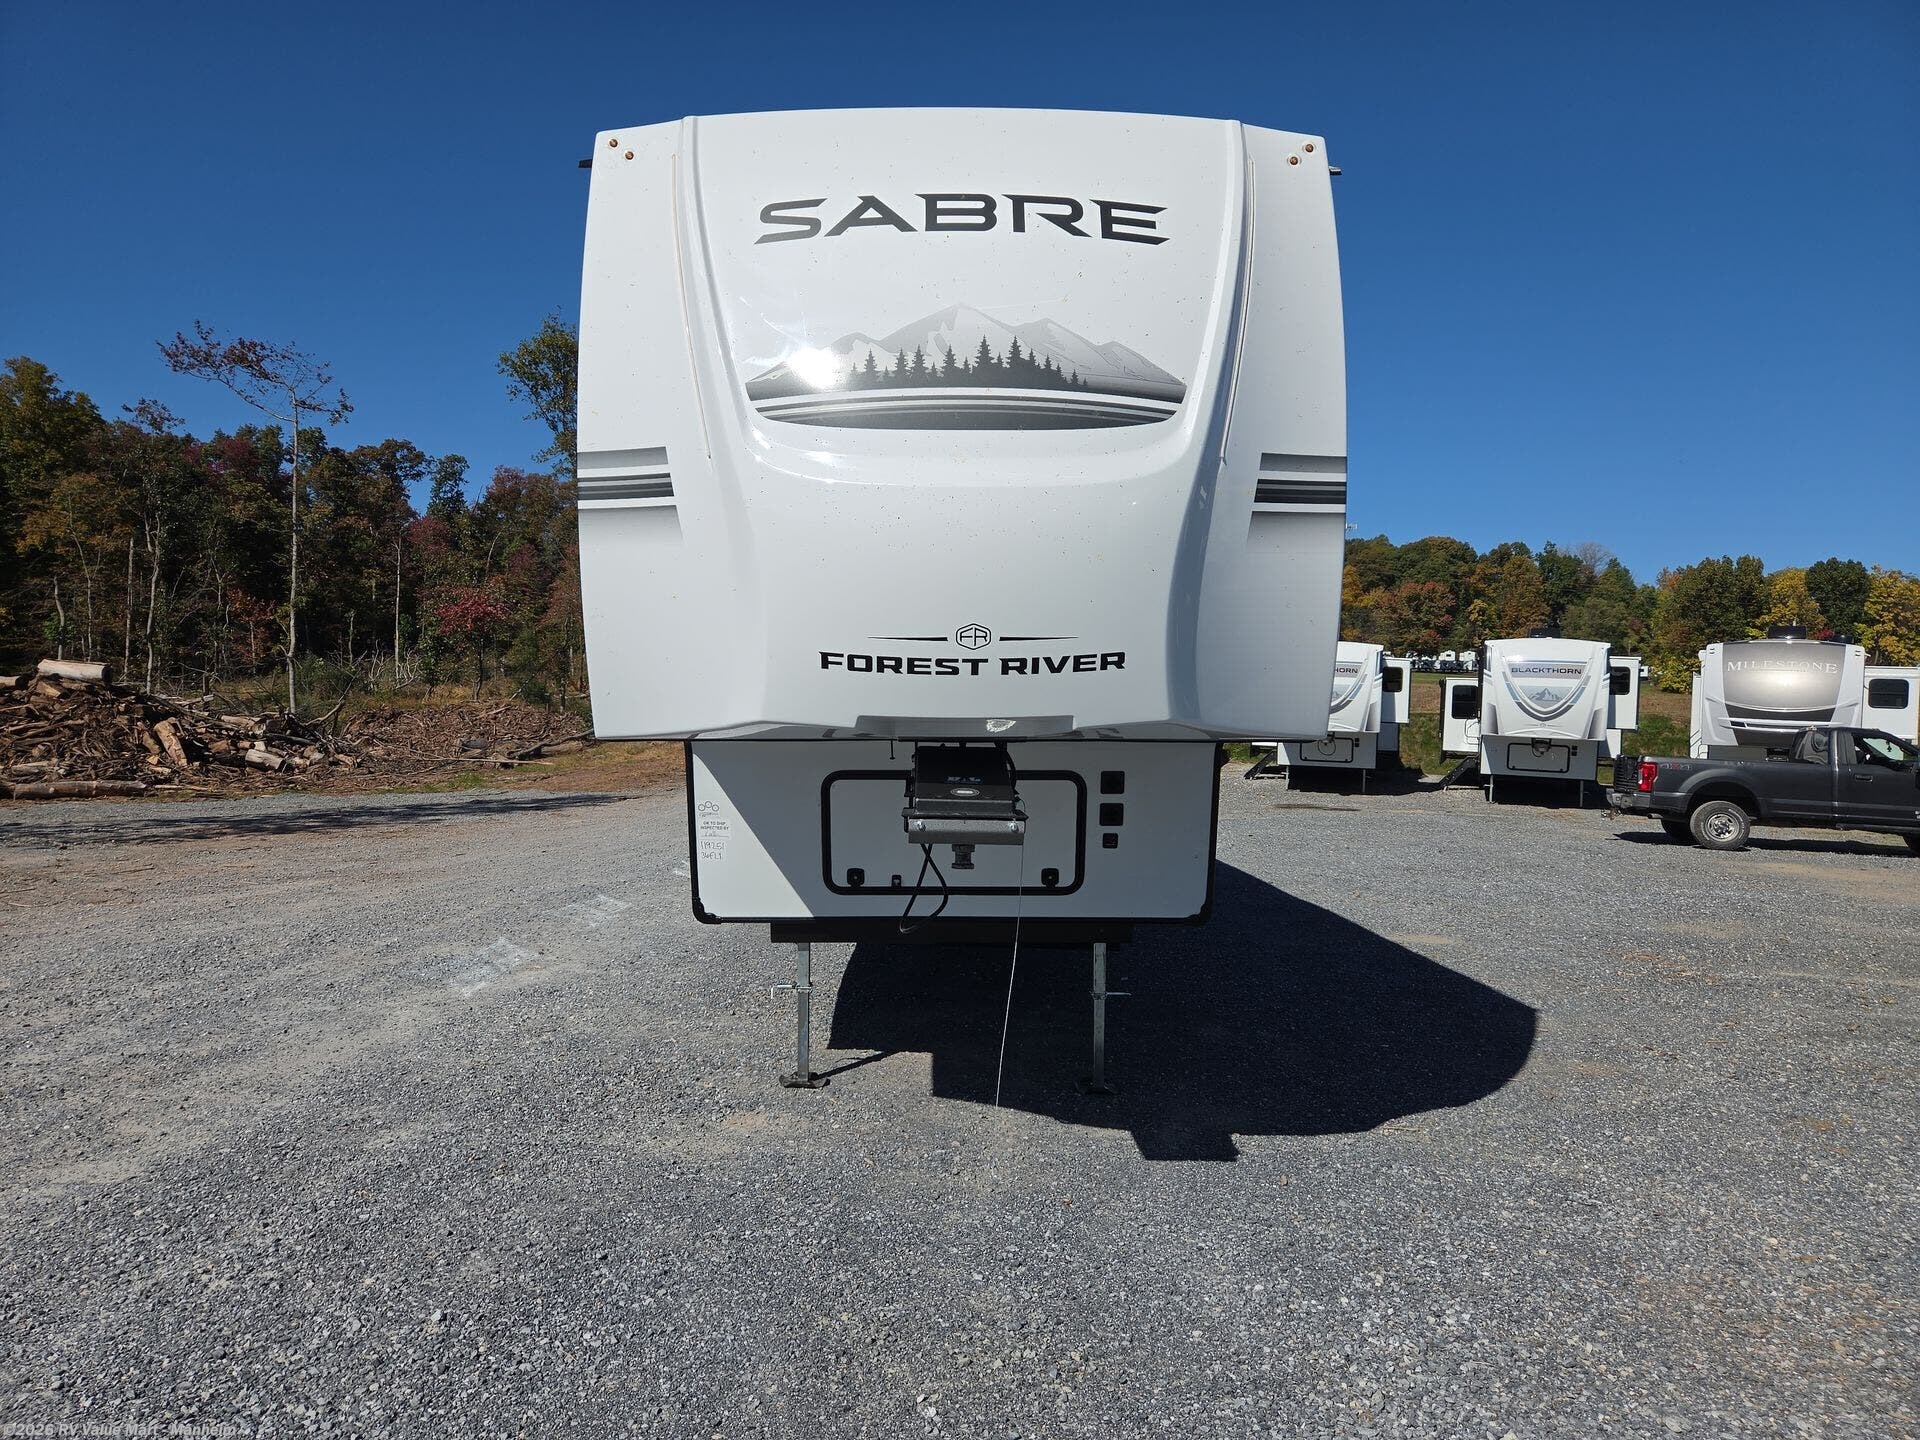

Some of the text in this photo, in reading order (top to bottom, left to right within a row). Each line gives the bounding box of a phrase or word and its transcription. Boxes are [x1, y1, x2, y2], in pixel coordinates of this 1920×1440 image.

[753, 193, 1170, 246] SABRE
[818, 650, 1126, 676] FOREST RIVER
[1510, 666, 1582, 675] BLACKTHORN
[1727, 660, 1838, 674] MILESTONE
